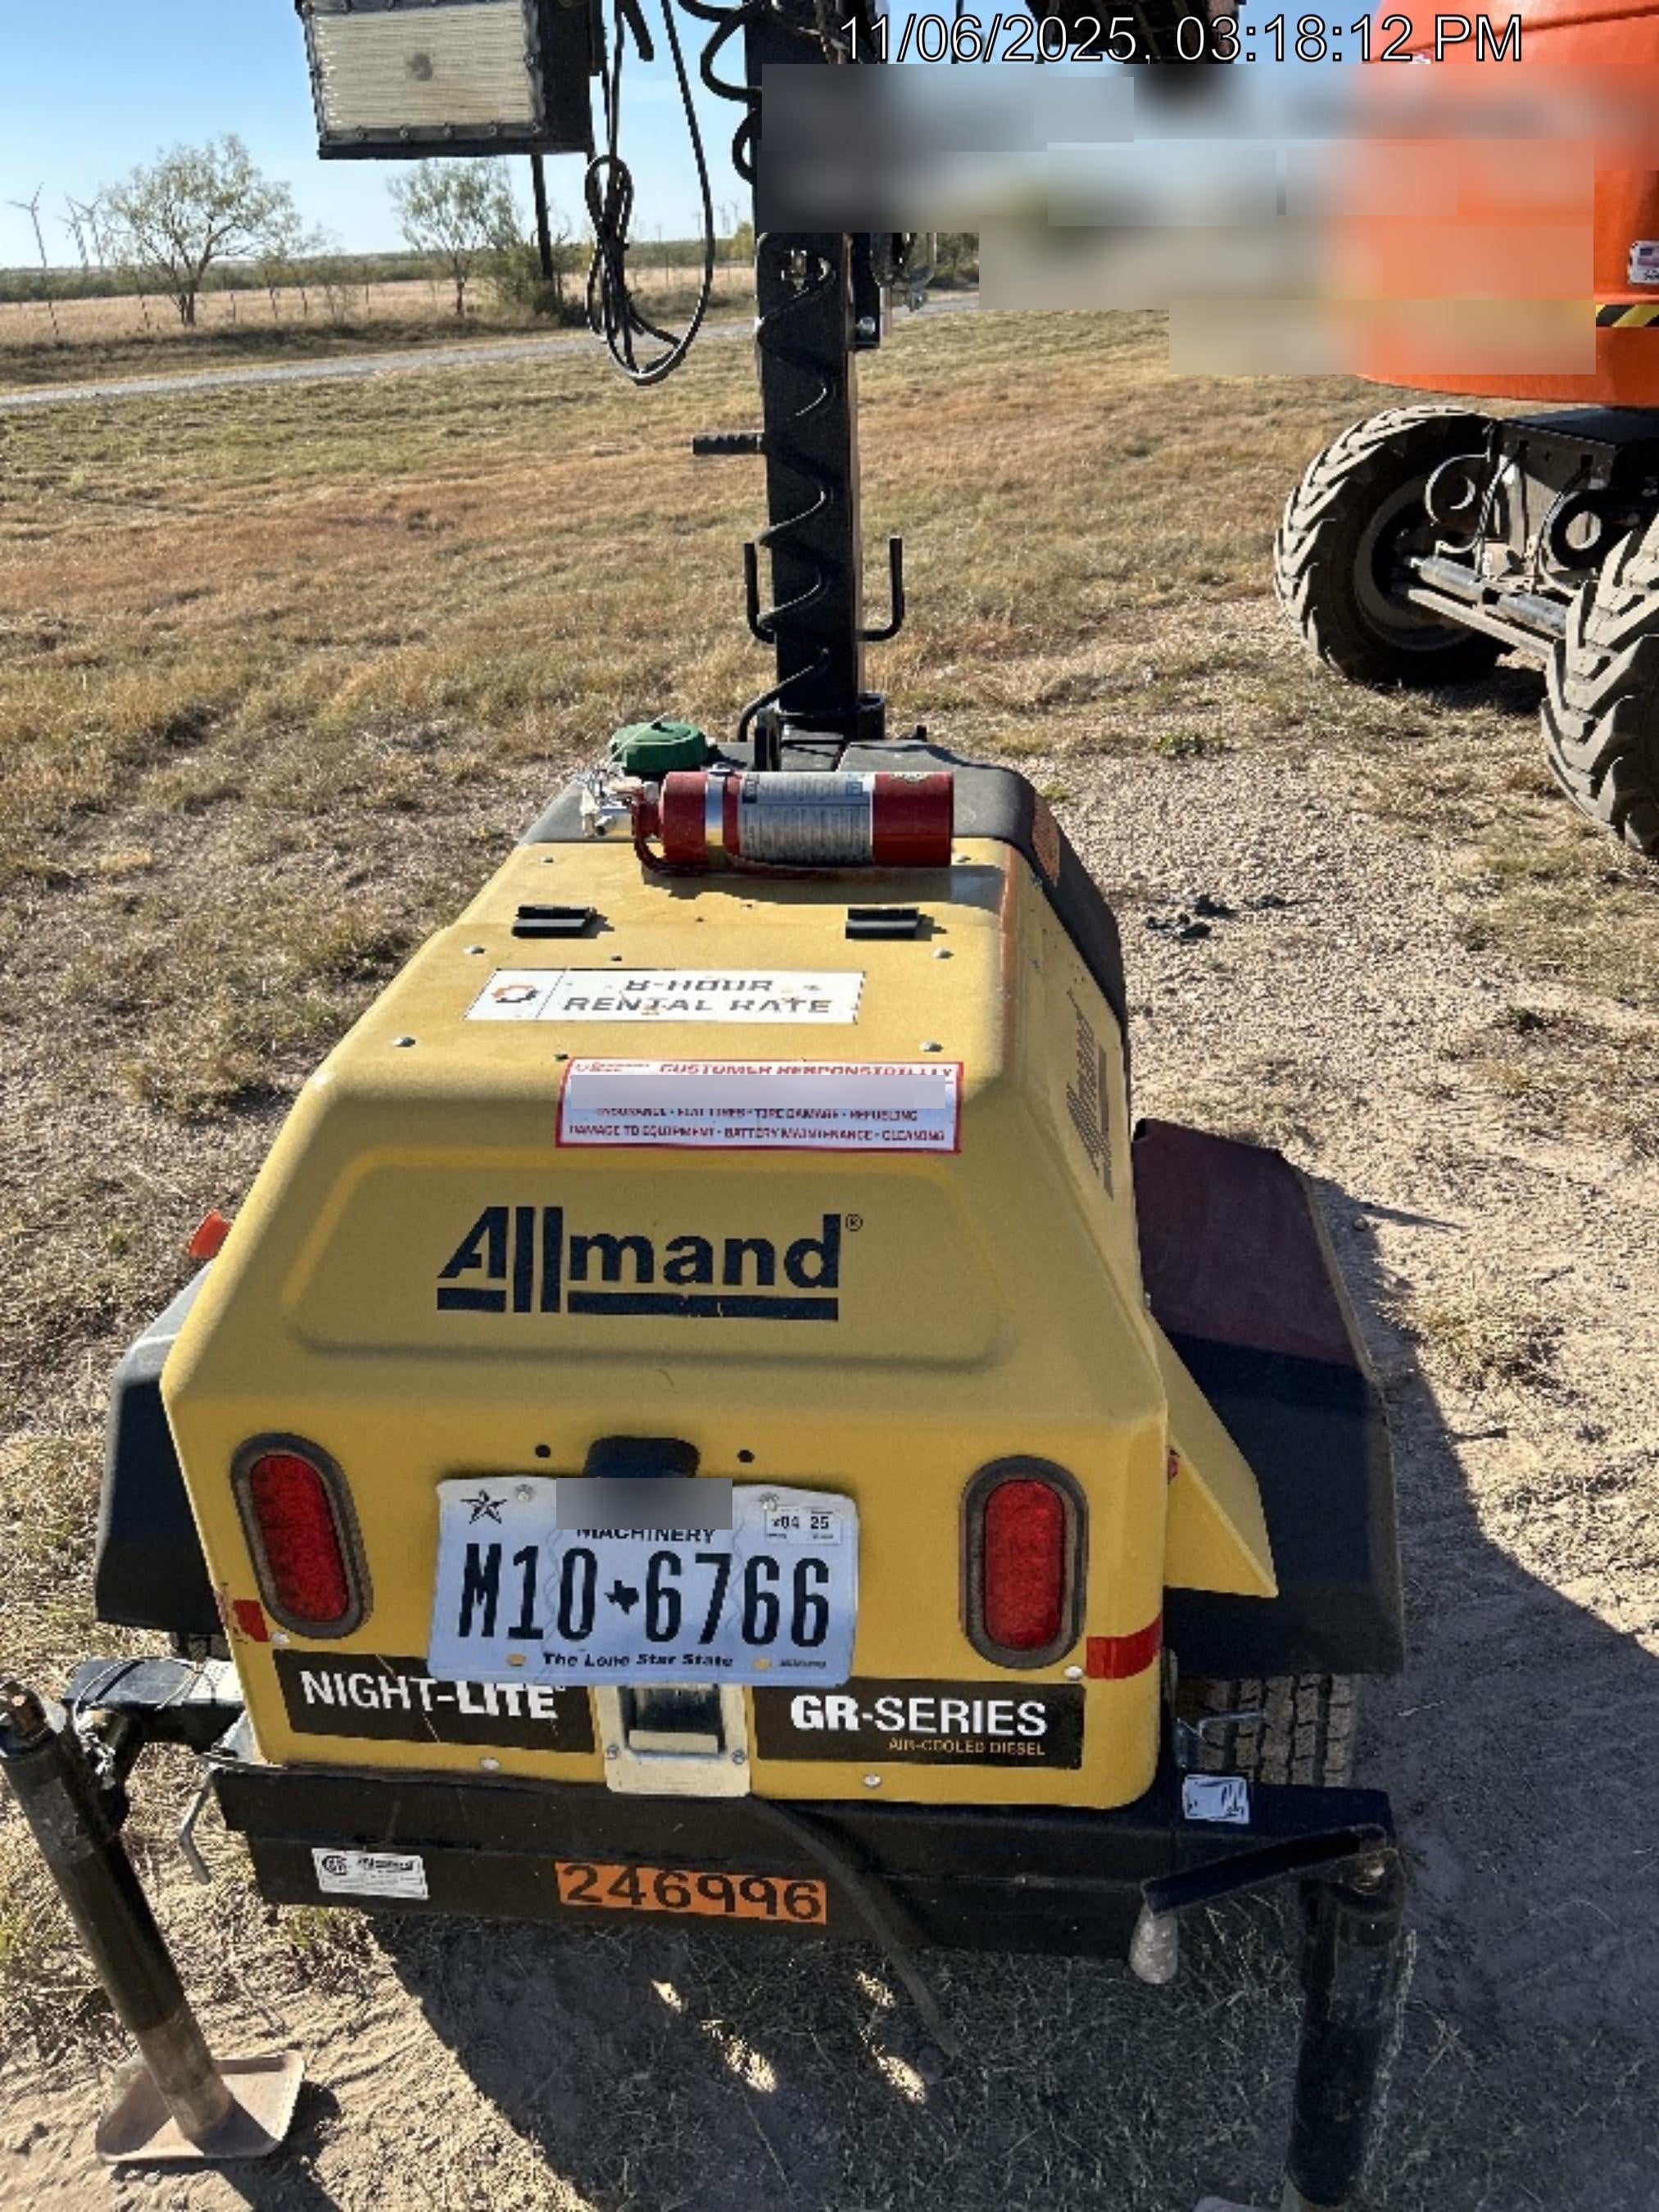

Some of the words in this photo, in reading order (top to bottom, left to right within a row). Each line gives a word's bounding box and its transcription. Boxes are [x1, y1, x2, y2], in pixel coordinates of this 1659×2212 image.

[563, 996, 714, 1012] RENTAL
[730, 999, 833, 1013] RATE
[437, 1206, 841, 1313] Allmand
[576, 1529, 716, 1544] MACHINERY
[810, 1516, 829, 1530] 25
[458, 1543, 598, 1642] M10
[645, 1550, 829, 1648] 6766
[543, 1652, 578, 1667] The
[584, 1652, 630, 1668] Lone
[636, 1653, 676, 1667] Star
[682, 1654, 734, 1668] State
[299, 1670, 560, 1720] NIGHT-LITE
[790, 1693, 1049, 1737] GR-SERIES
[889, 1737, 985, 1754] AIR-COOLED
[990, 1742, 1046, 1756] DIESEL
[562, 1864, 823, 1920] 246996
